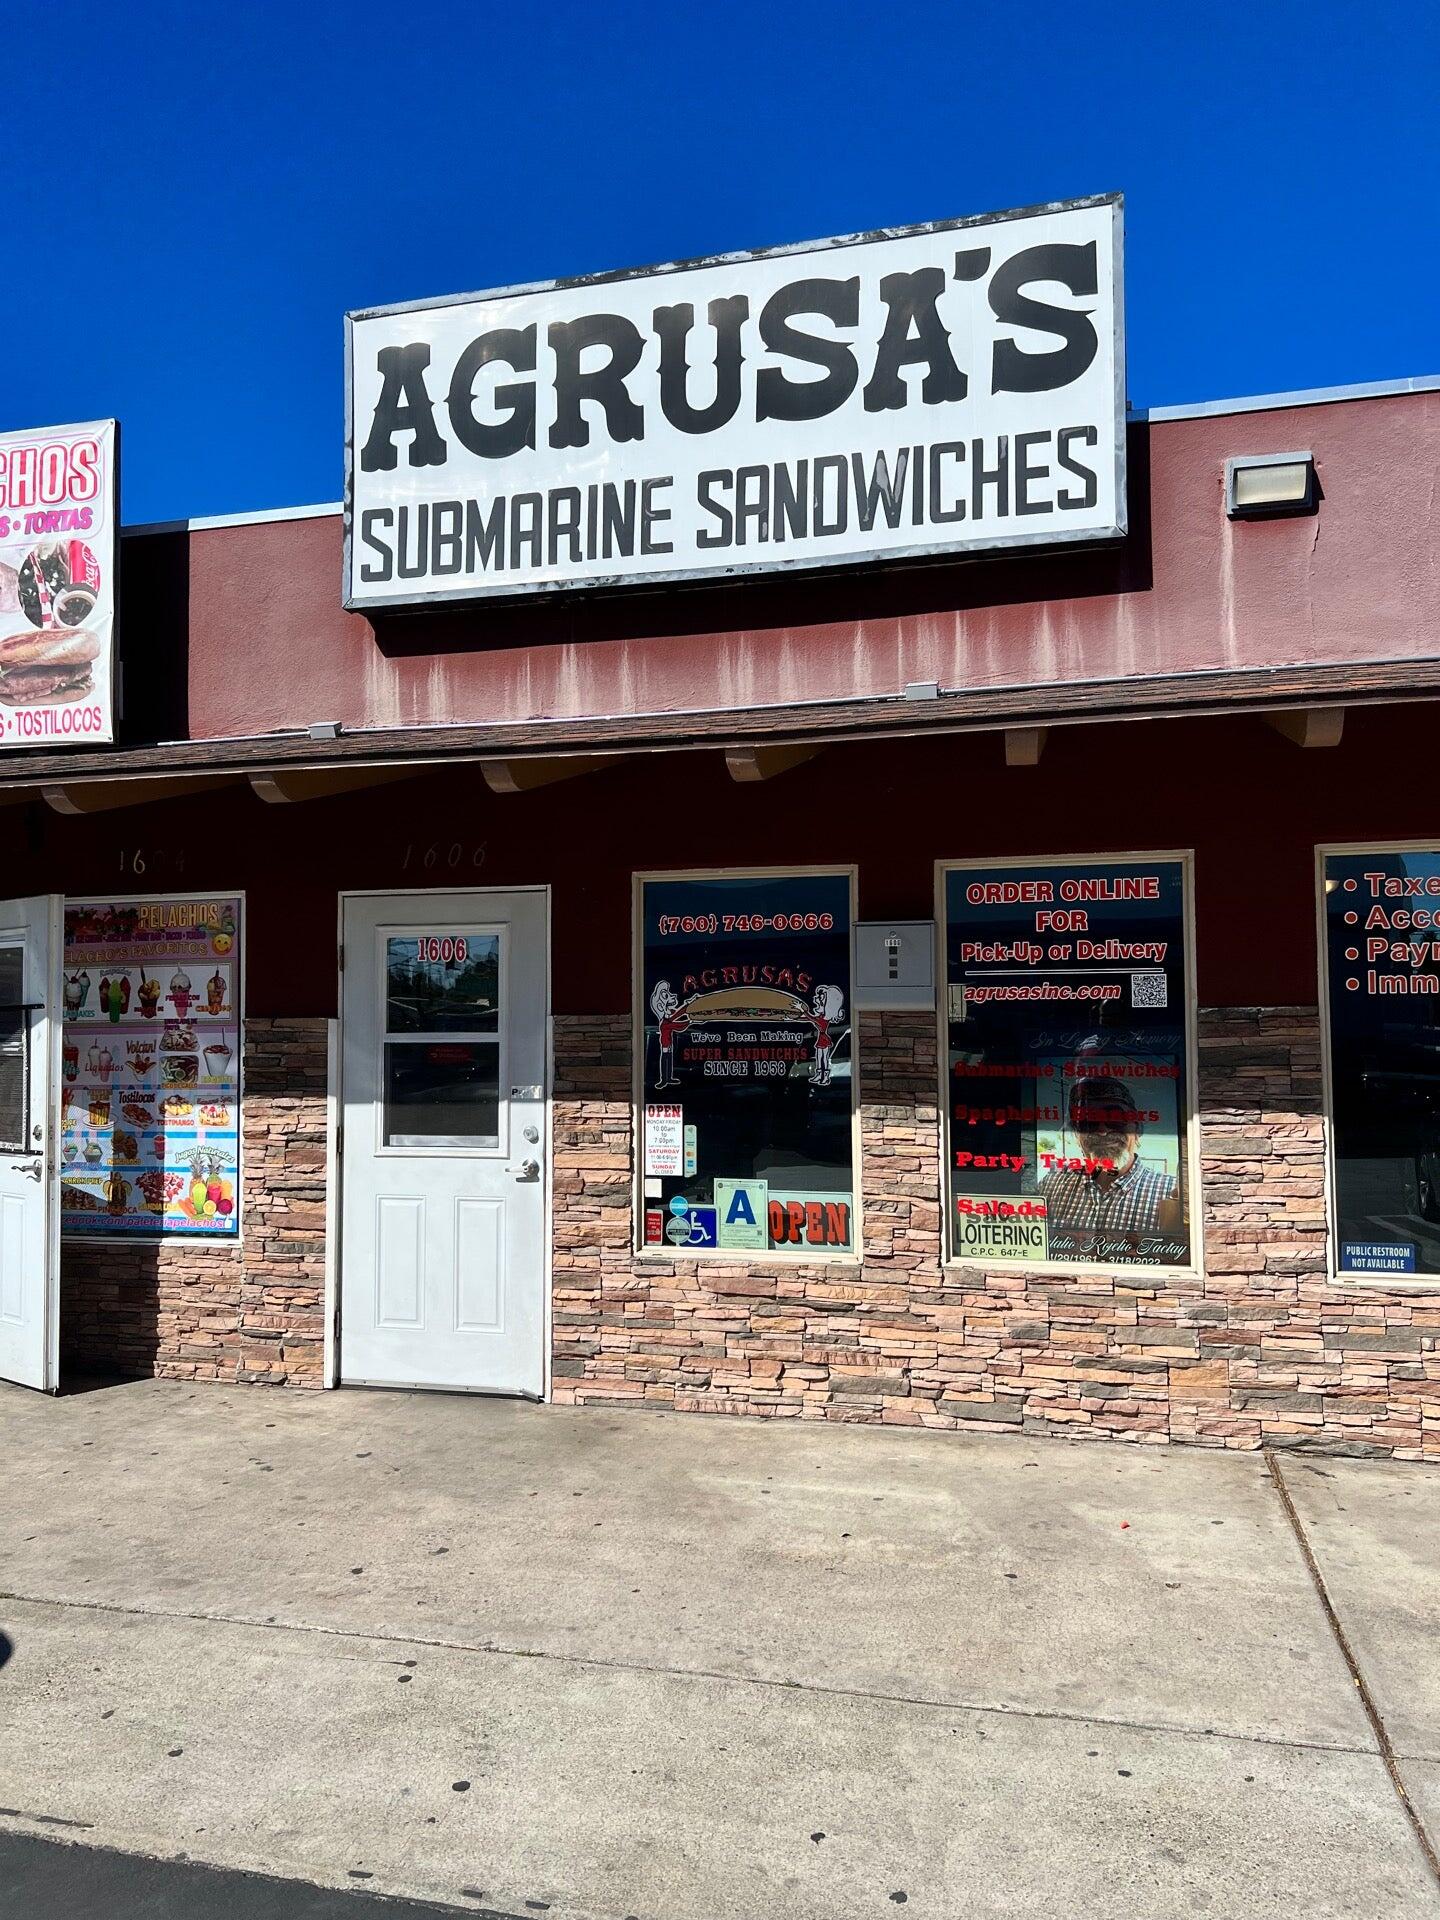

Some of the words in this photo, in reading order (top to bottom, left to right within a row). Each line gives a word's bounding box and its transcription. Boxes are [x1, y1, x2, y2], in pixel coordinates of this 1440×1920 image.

[361, 240, 1099, 472] AGRUSA'S
[361, 476, 673, 583] SUBMARINE
[697, 425, 1098, 549] SANDWICHES
[24, 507, 93, 535] TORTAS
[15, 706, 102, 736] TOSTILOCOS
[402, 840, 488, 869] 1606
[967, 881, 1054, 904] ORDER
[1060, 877, 1159, 900] ONLINE
[139, 903, 219, 929] PELACHOS
[659, 914, 717, 935] (760)
[723, 913, 833, 931] 746-0666
[1036, 910, 1088, 932] FOR
[417, 937, 467, 962] 1606
[961, 942, 1043, 964] Pick-Up
[1048, 944, 1072, 960] or
[1077, 939, 1167, 962] Delivery
[683, 965, 812, 993] AGRUSA'S
[964, 982, 1121, 1004] agrusasinc.com
[691, 1032, 721, 1043] We've
[727, 1032, 757, 1042] Been
[761, 1031, 803, 1043] Making
[683, 1048, 721, 1060] SUPER
[727, 1048, 808, 1060] SANDWICHES
[704, 1061, 748, 1075] SINCE
[754, 1061, 786, 1075] 1958
[1063, 1061, 1181, 1078] Sandwiches
[648, 1104, 681, 1118] OPEN
[955, 1105, 1060, 1124] Spaghetti
[956, 1152, 1025, 1173] Party
[1040, 1154, 1116, 1174] Trays
[725, 1189, 757, 1225] A
[957, 1199, 1048, 1217] Salads
[768, 1200, 850, 1244] OPEN
[957, 1223, 1042, 1247] LOITERING
[971, 1247, 997, 1256] C.P.C.
[1001, 1249, 1028, 1257] 647-E
[1346, 1246, 1371, 1256] PUBLIC
[1373, 1247, 1410, 1257] RESTROOM
[1351, 1258, 1366, 1267] NOT
[1367, 1259, 1405, 1269] AVAILABLE
